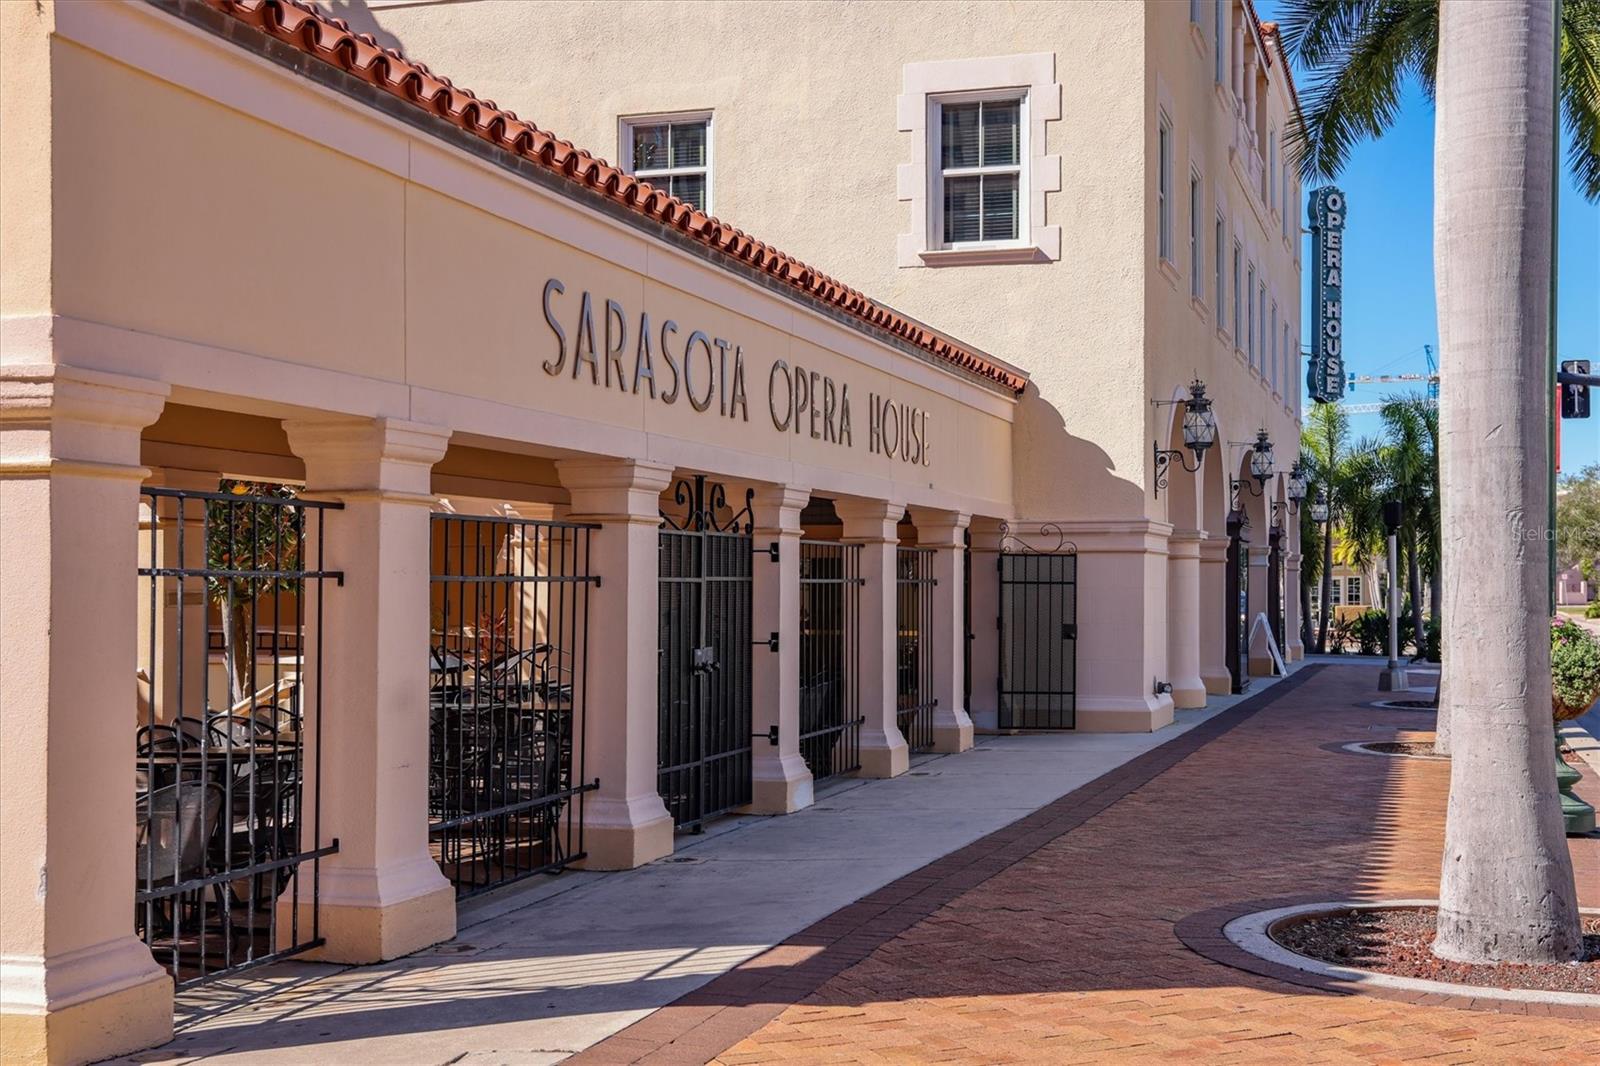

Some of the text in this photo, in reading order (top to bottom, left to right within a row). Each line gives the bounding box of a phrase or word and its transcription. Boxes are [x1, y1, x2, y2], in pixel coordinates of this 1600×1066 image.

[542, 278, 931, 468] SARASOTA OPERA HOUSE
[1326, 193, 1342, 393] OPERA HOUSE
